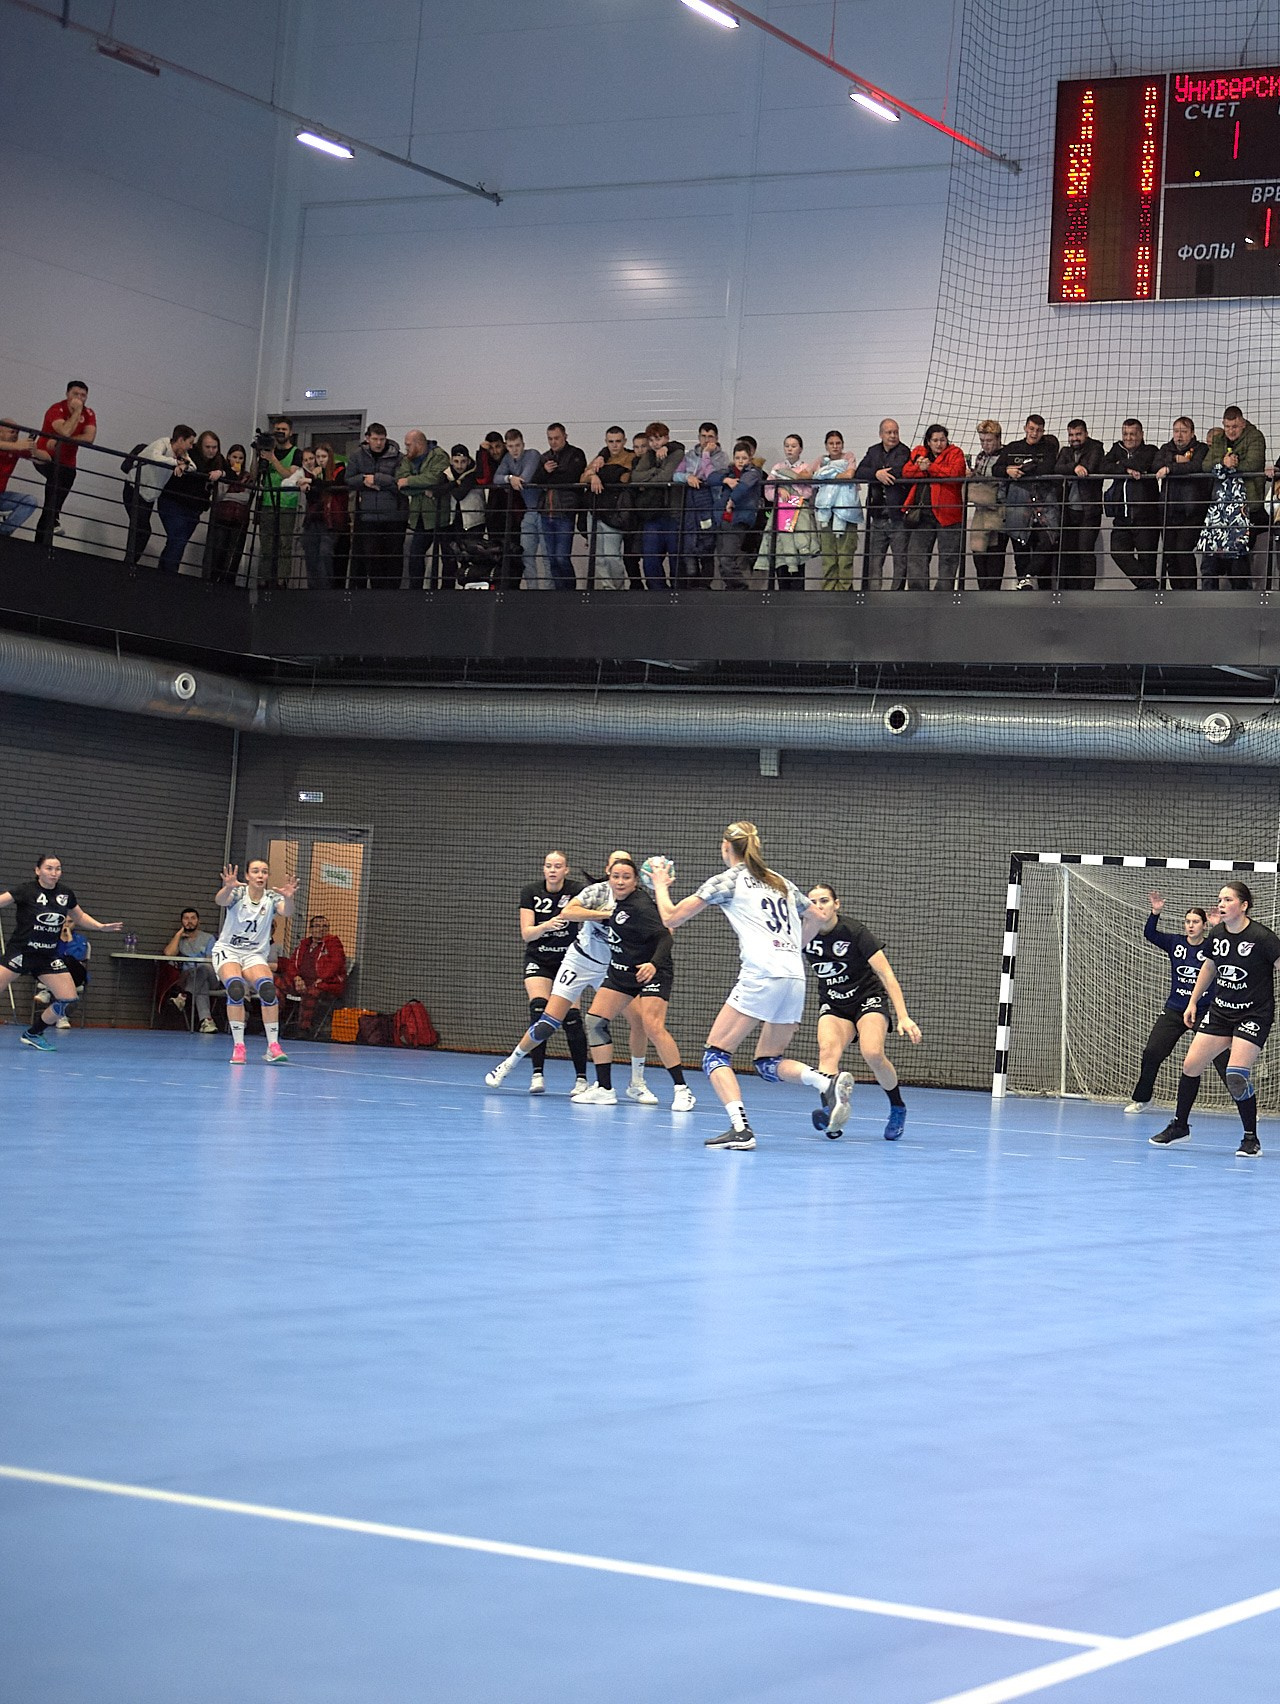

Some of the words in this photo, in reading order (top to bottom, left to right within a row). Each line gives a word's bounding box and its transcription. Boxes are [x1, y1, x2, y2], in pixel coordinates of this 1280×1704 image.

[1184, 101, 1240, 120] СЧЕТ
[1232, 120, 1240, 160] 1
[1177, 242, 1236, 261] ФОЛЫ
[36, 892, 49, 906] 4
[533, 896, 553, 914] 22
[761, 897, 791, 936] 39
[244, 919, 258, 933] 71
[1173, 944, 1187, 960] 81
[1212, 938, 1230, 957] 30
[559, 969, 577, 987] 67
